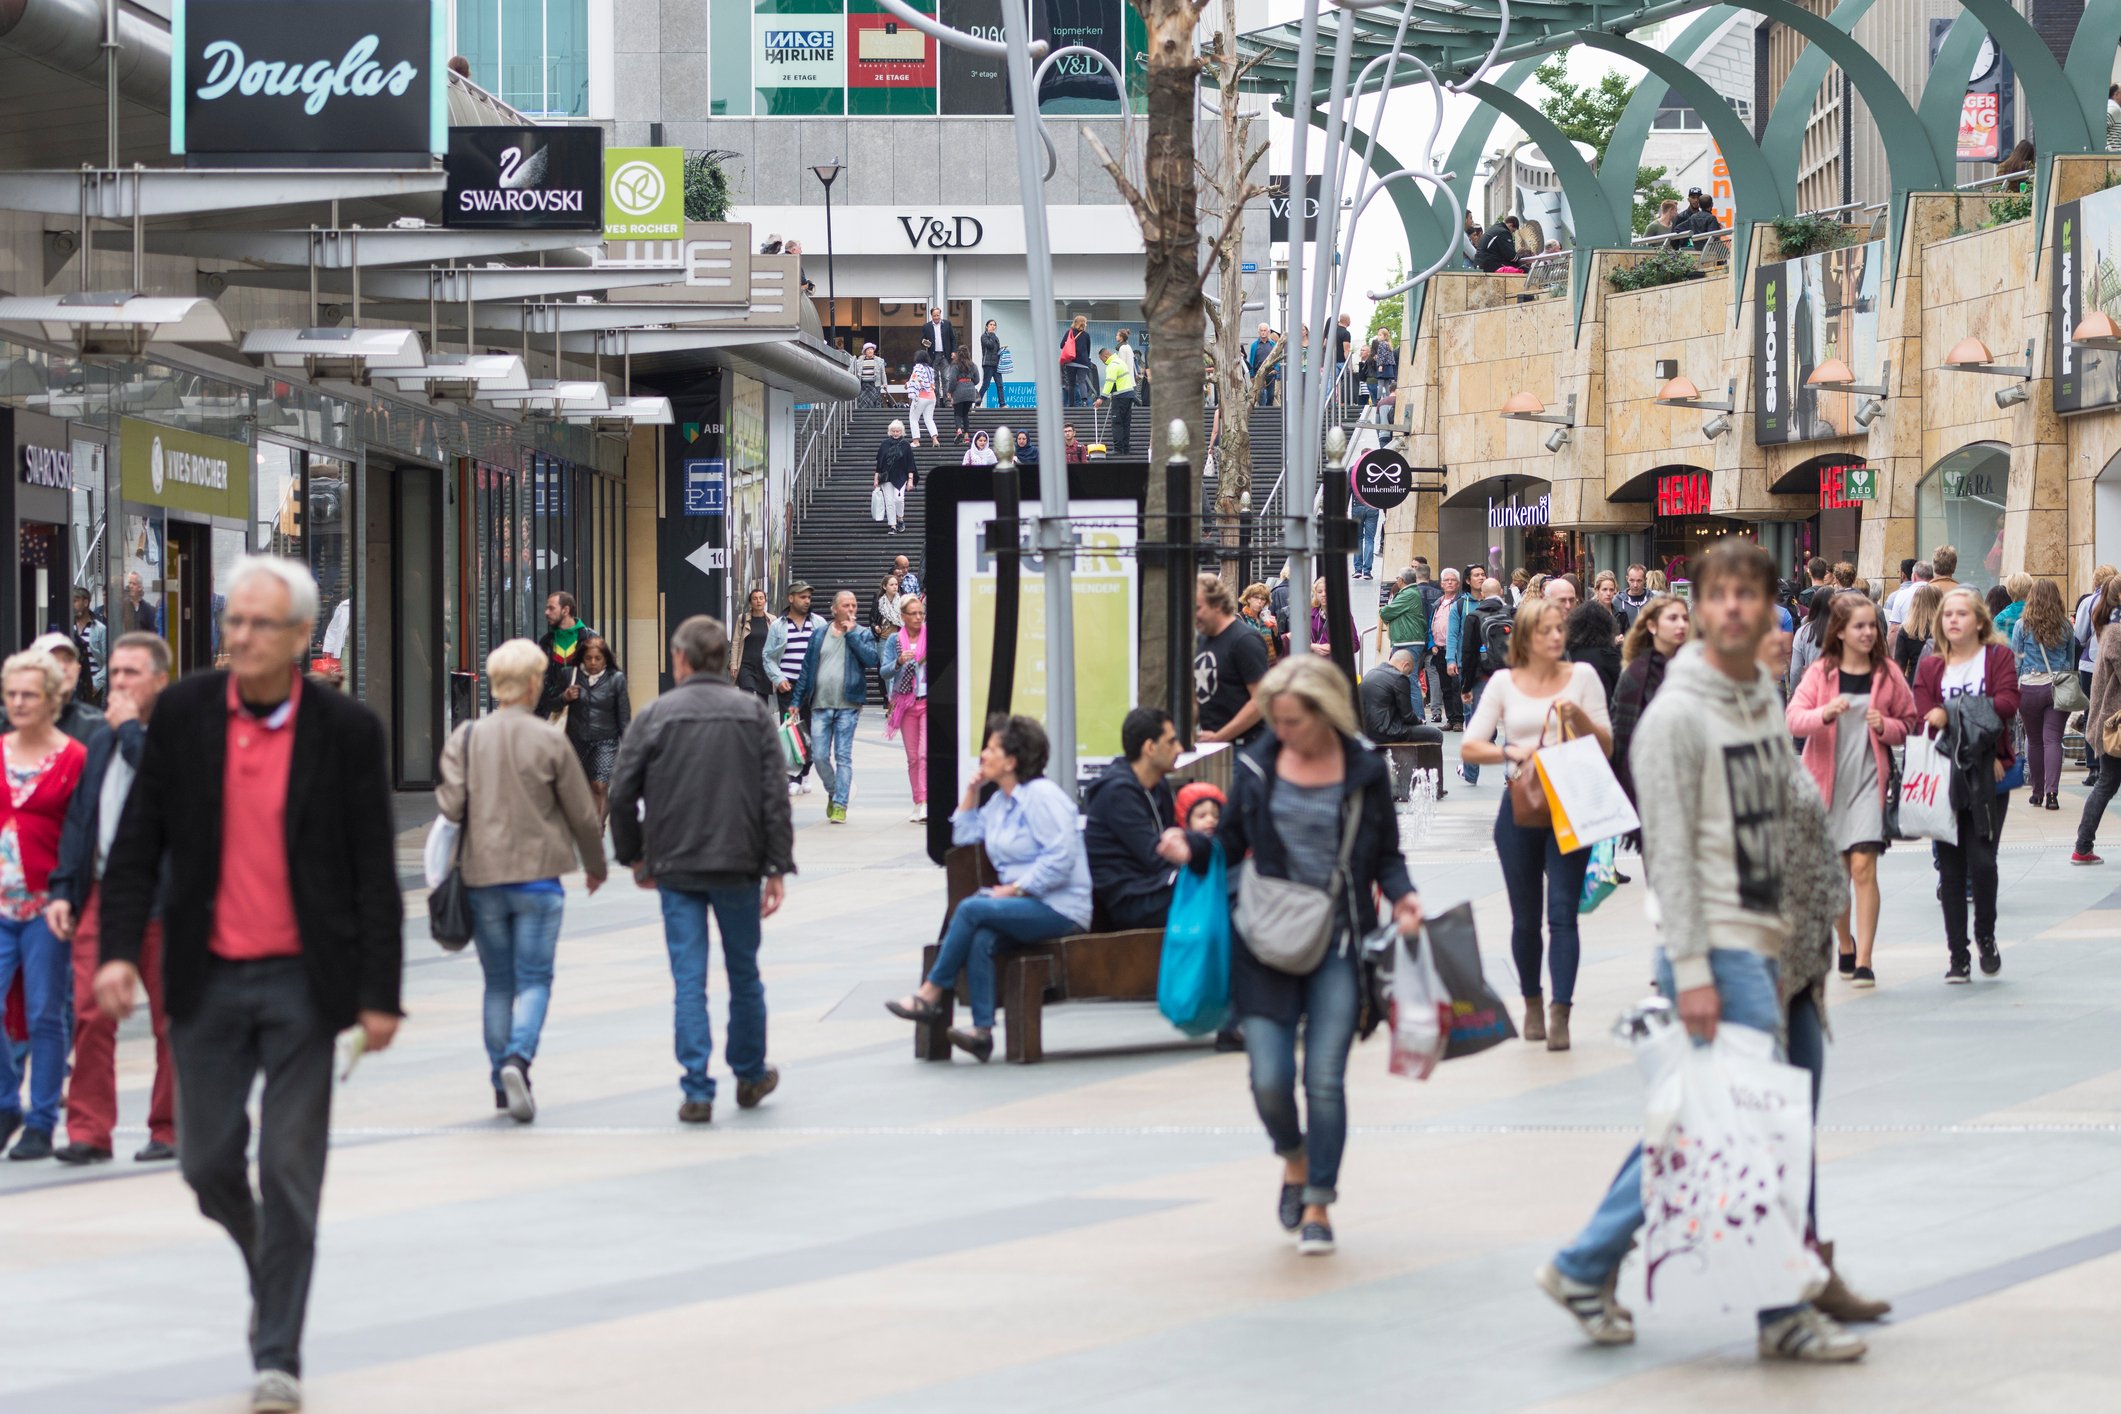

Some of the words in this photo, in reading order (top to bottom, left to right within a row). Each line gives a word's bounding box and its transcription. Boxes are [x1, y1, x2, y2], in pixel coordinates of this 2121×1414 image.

[766, 32, 833, 48] IMAGE
[1053, 27, 1103, 35] topmerken
[765, 49, 834, 64] HAIRLINE
[1055, 56, 1103, 75] V&D
[197, 34, 418, 115] Douglas
[1963, 96, 1996, 108] GER
[460, 190, 583, 211] SWAROVSKI
[605, 224, 627, 234] VES
[630, 224, 678, 234] ROCHER
[897, 216, 984, 249] V&D
[25, 444, 72, 489] SWAROVSKI
[166, 450, 191, 481] YVES
[192, 456, 228, 489] ROCHER
[1361, 485, 1406, 494] hunkemöller
[1658, 472, 1711, 516] HEMA
[1820, 464, 1866, 510] HE
[1956, 473, 1994, 497] ZARA
